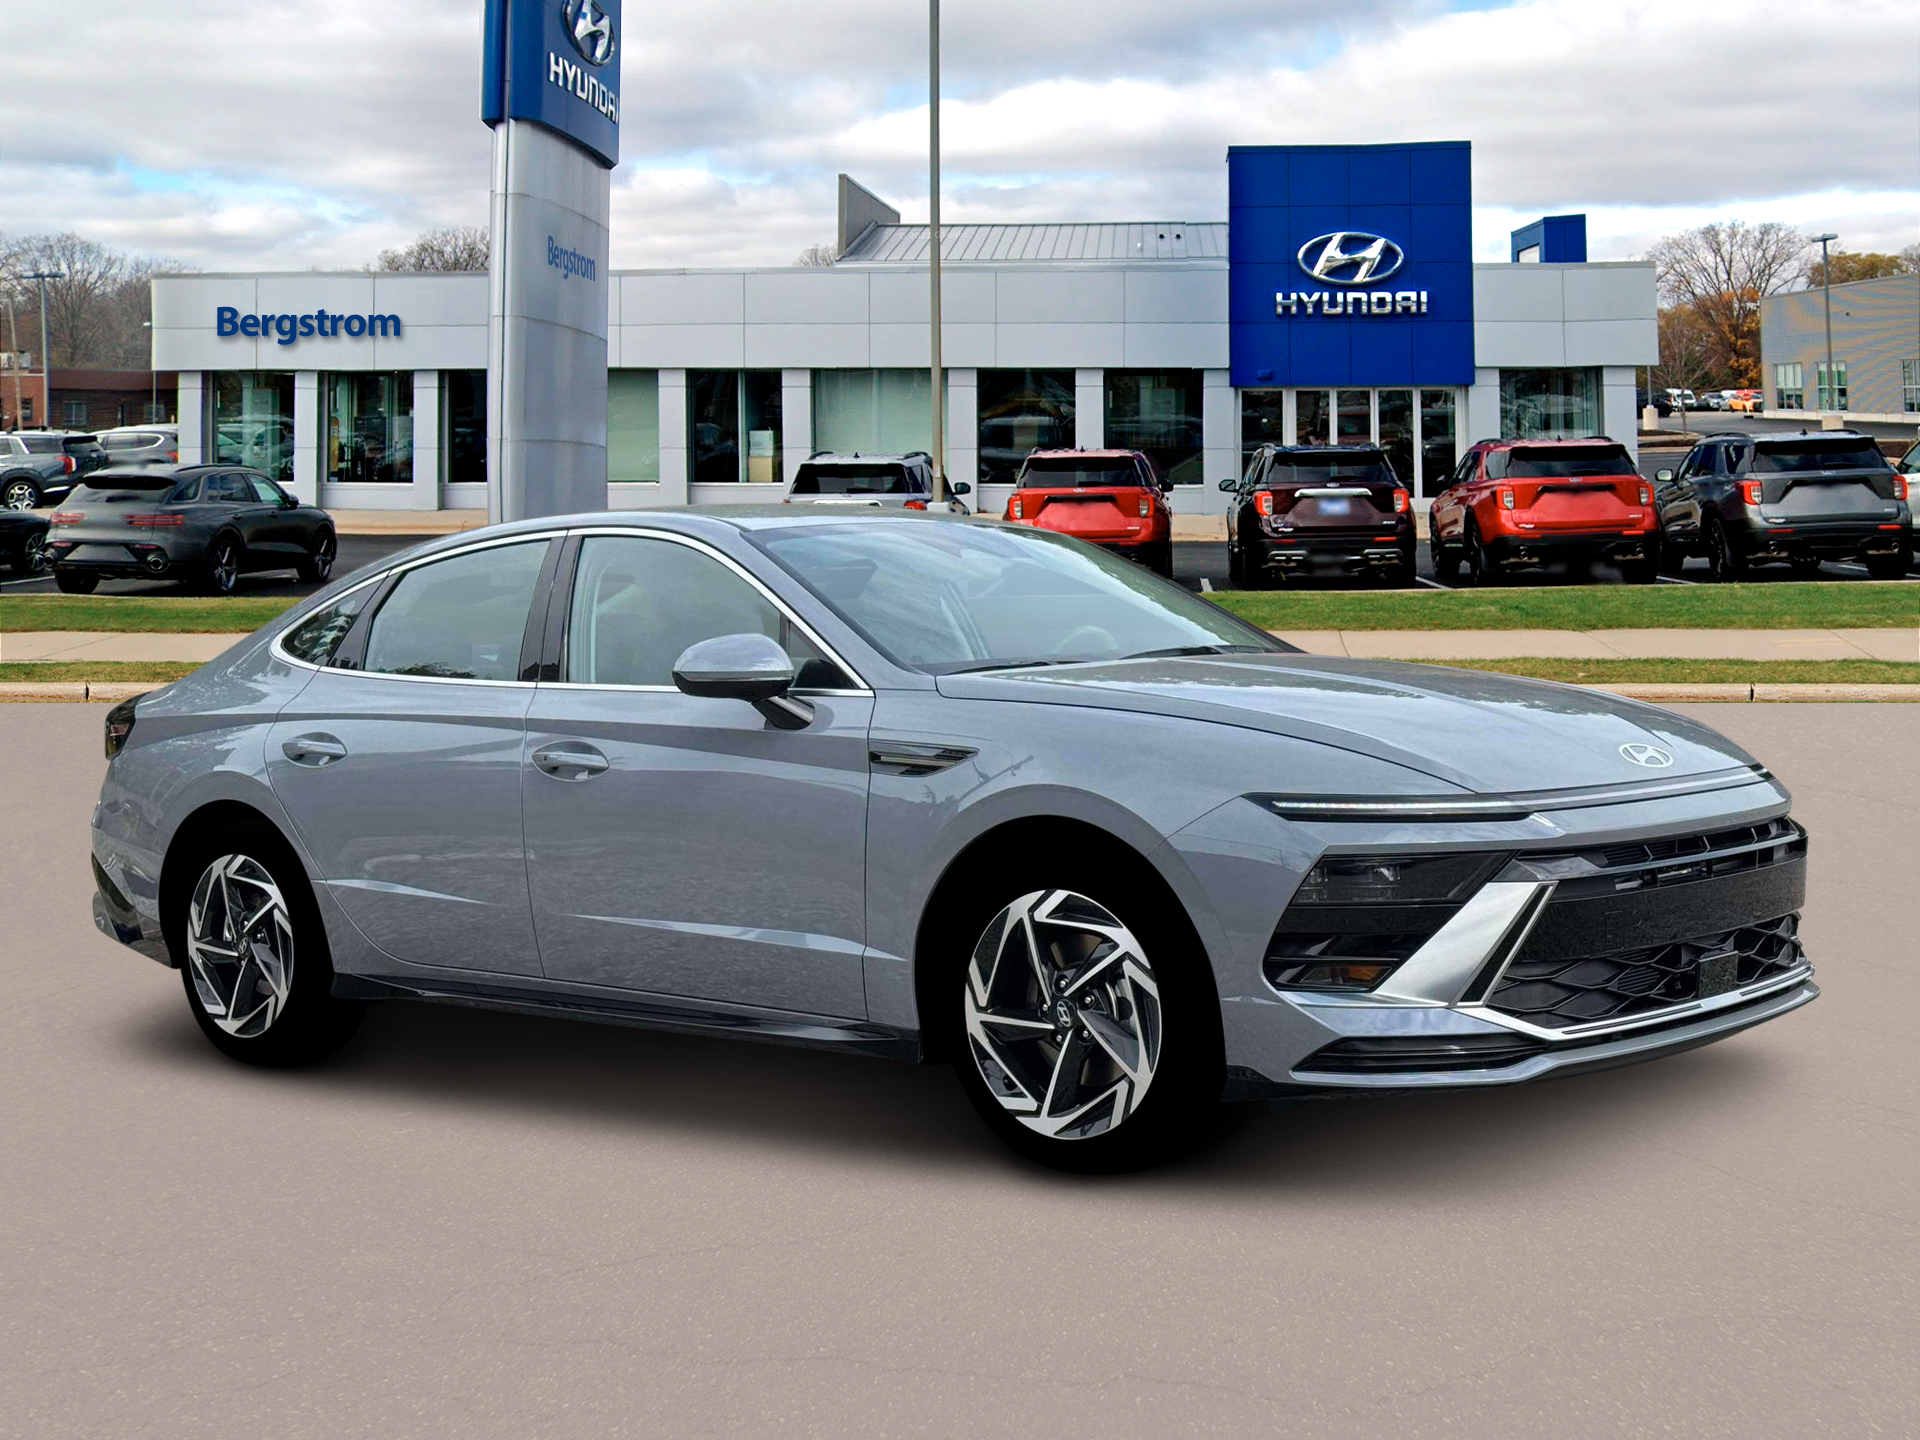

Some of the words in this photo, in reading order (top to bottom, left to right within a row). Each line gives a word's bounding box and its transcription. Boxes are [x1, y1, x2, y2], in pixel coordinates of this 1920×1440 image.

[549, 52, 619, 124] HYUNDAI
[547, 234, 596, 282] Bergstrom
[1275, 290, 1428, 316] HYUNDAI
[216, 306, 402, 346] Bergstrom
